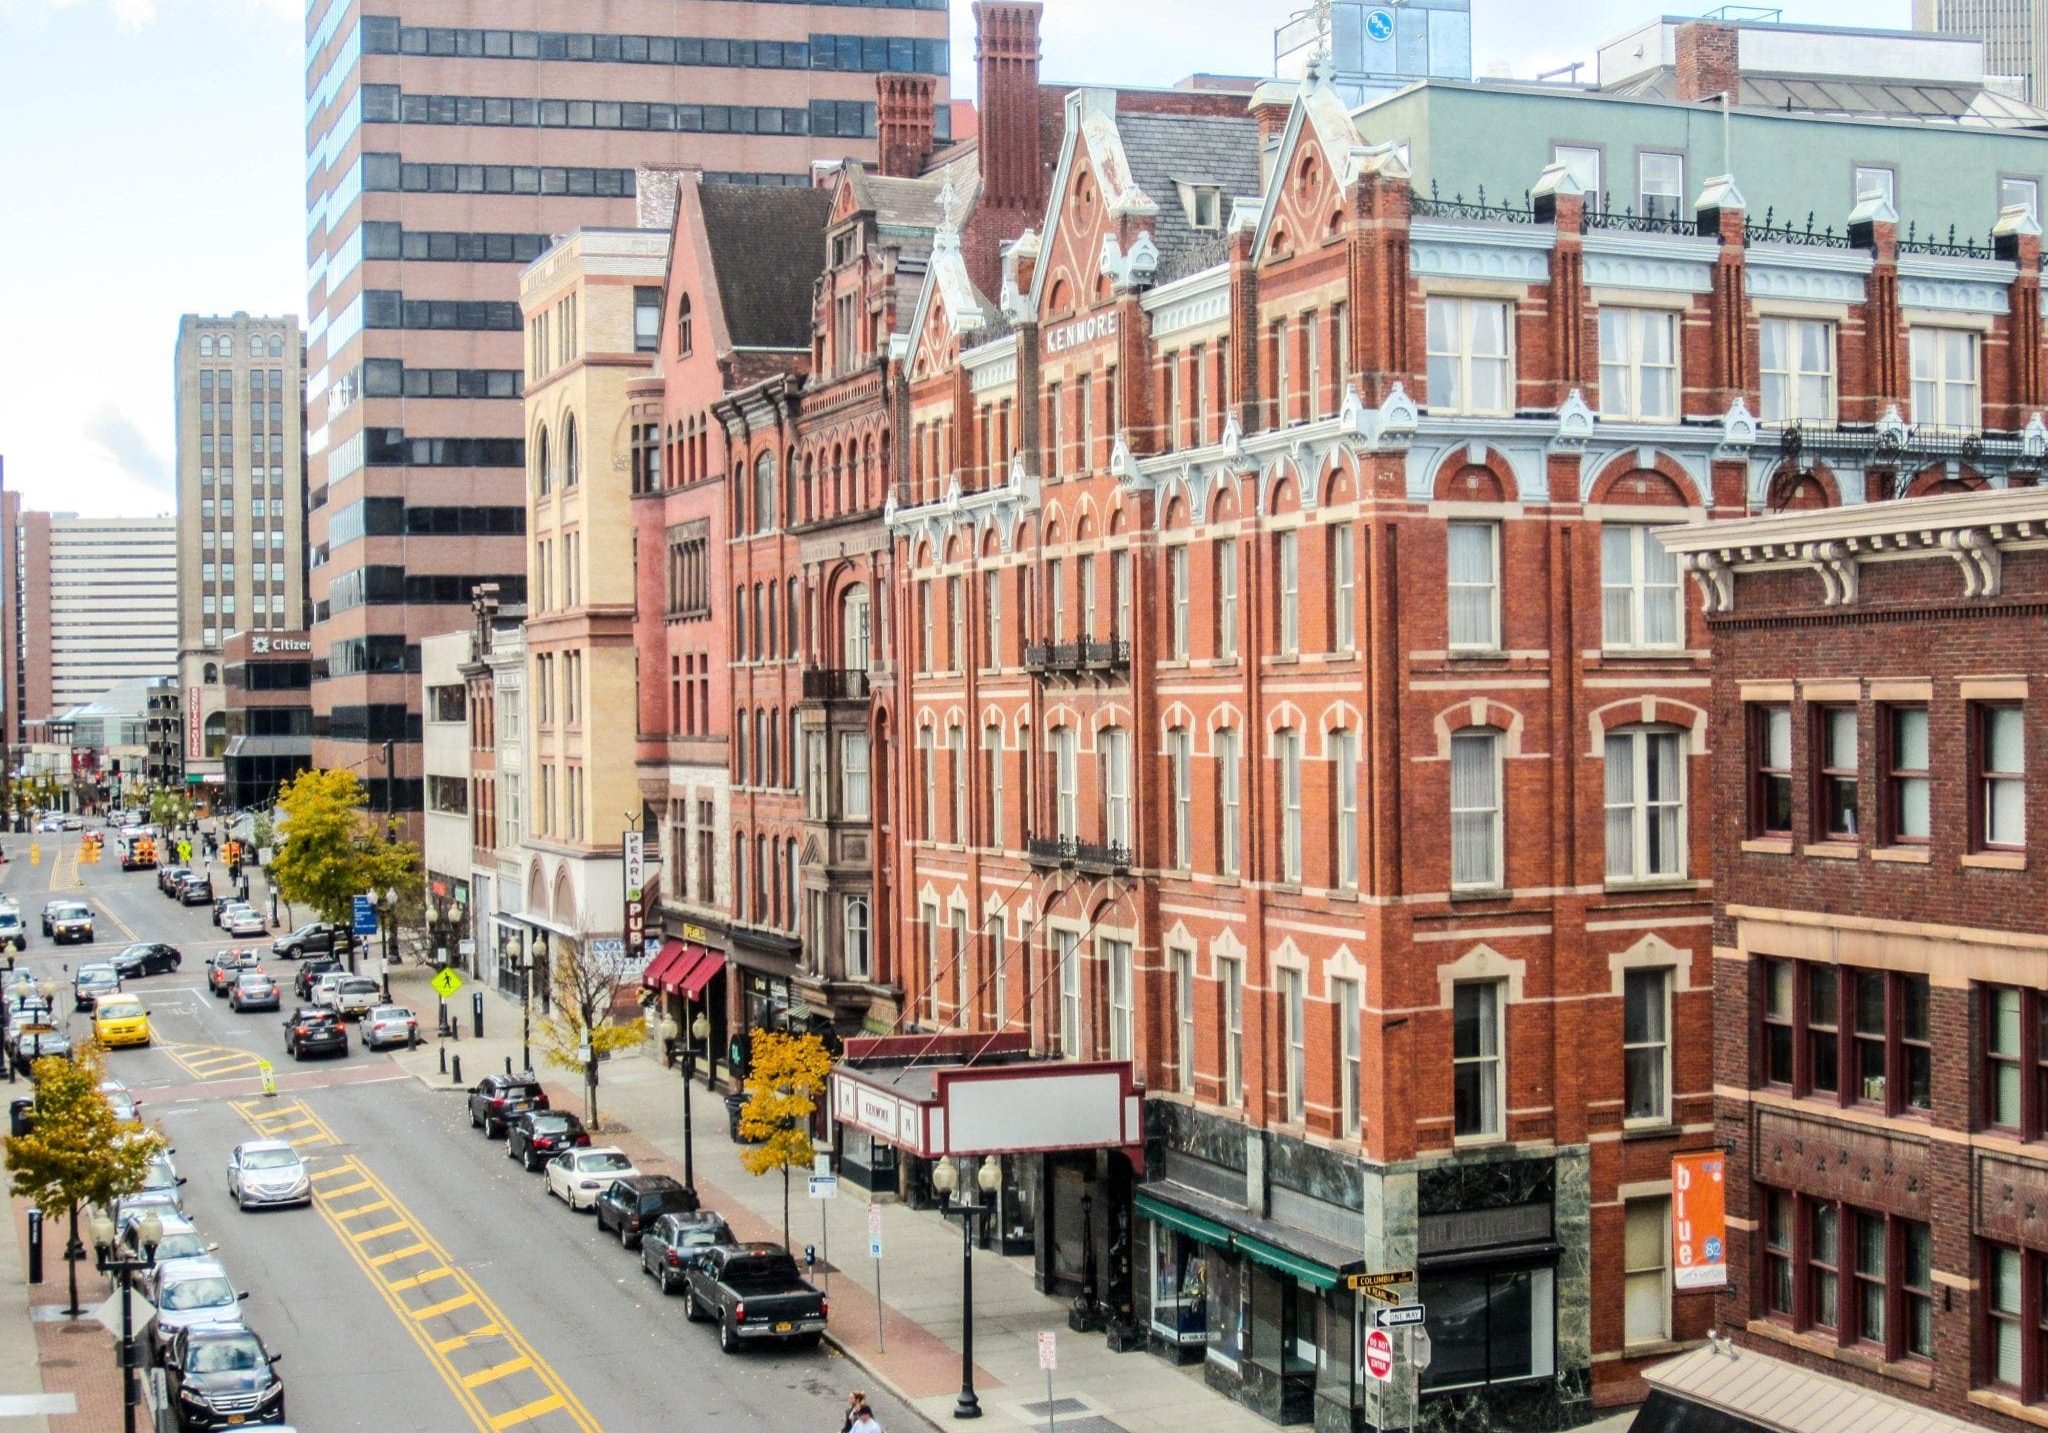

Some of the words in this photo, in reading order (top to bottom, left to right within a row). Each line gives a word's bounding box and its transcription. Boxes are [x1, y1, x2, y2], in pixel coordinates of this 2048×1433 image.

[1047, 310, 1117, 353] KENMORE
[629, 835, 640, 886] PEARL
[629, 903, 643, 945] PUB
[1677, 1163, 1692, 1266] blue
[1705, 1242, 1721, 1257] 82
[1360, 1275, 1395, 1286] COLUMBIA
[1390, 1312, 1402, 1321] ONE
[1405, 1311, 1419, 1319] WAY
[1369, 1337, 1378, 1347] DO
[1378, 1339, 1389, 1350] NOT
[1371, 1359, 1387, 1371] ENTER
